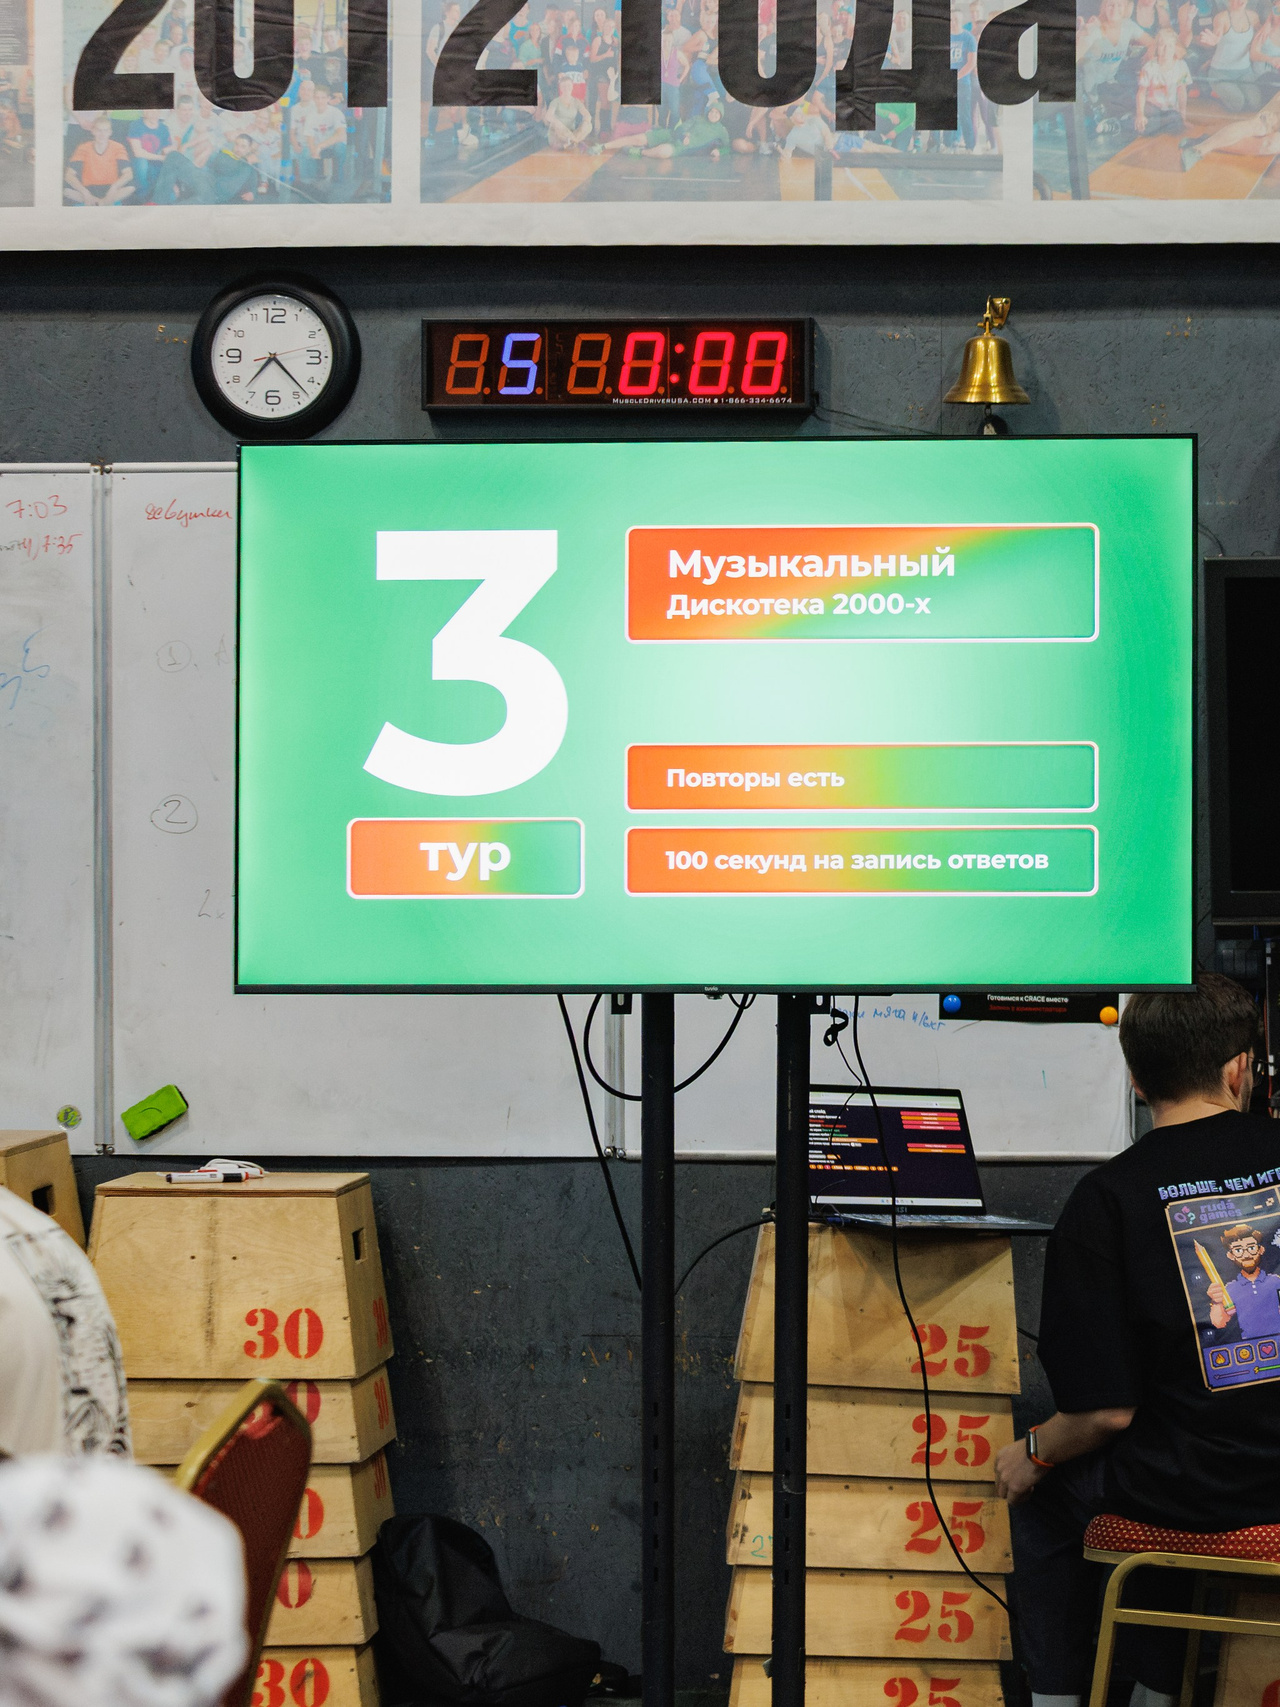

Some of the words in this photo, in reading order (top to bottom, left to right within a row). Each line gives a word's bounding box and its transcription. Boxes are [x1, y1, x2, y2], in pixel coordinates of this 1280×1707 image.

[250, 313, 258, 322] 11
[263, 308, 287, 324] 12
[294, 313, 299, 322] 1
[233, 330, 245, 338] 10
[308, 330, 317, 339] 2
[226, 348, 242, 364] 9
[306, 349, 322, 365] 3
[232, 375, 241, 384] 8
[307, 376, 315, 384] 4
[248, 391, 256, 399] 7
[265, 389, 281, 406] 6
[292, 391, 300, 400] 5
[668, 546, 956, 585] Музыкальный
[666, 593, 825, 620] Дискотека
[832, 592, 931, 615] 2000-х
[363, 529, 568, 797] 3
[666, 769, 781, 793] Повторы
[787, 770, 845, 788] есть
[419, 841, 511, 882] тур
[665, 851, 708, 870] 100
[714, 852, 807, 875] секунд
[813, 854, 844, 870] на
[851, 852, 942, 870] запись
[948, 851, 1049, 870] ответов
[1158, 1180, 1223, 1201] БОЛЬШЕ,
[1224, 1174, 1255, 1191] ЧЕМ
[1200, 1207, 1243, 1224] games
[243, 1308, 324, 1360] 30
[910, 1323, 991, 1378] 25
[911, 1413, 991, 1467] 25
[905, 1500, 985, 1555] 25
[895, 1590, 974, 1644] 25
[251, 1657, 330, 1707] 30
